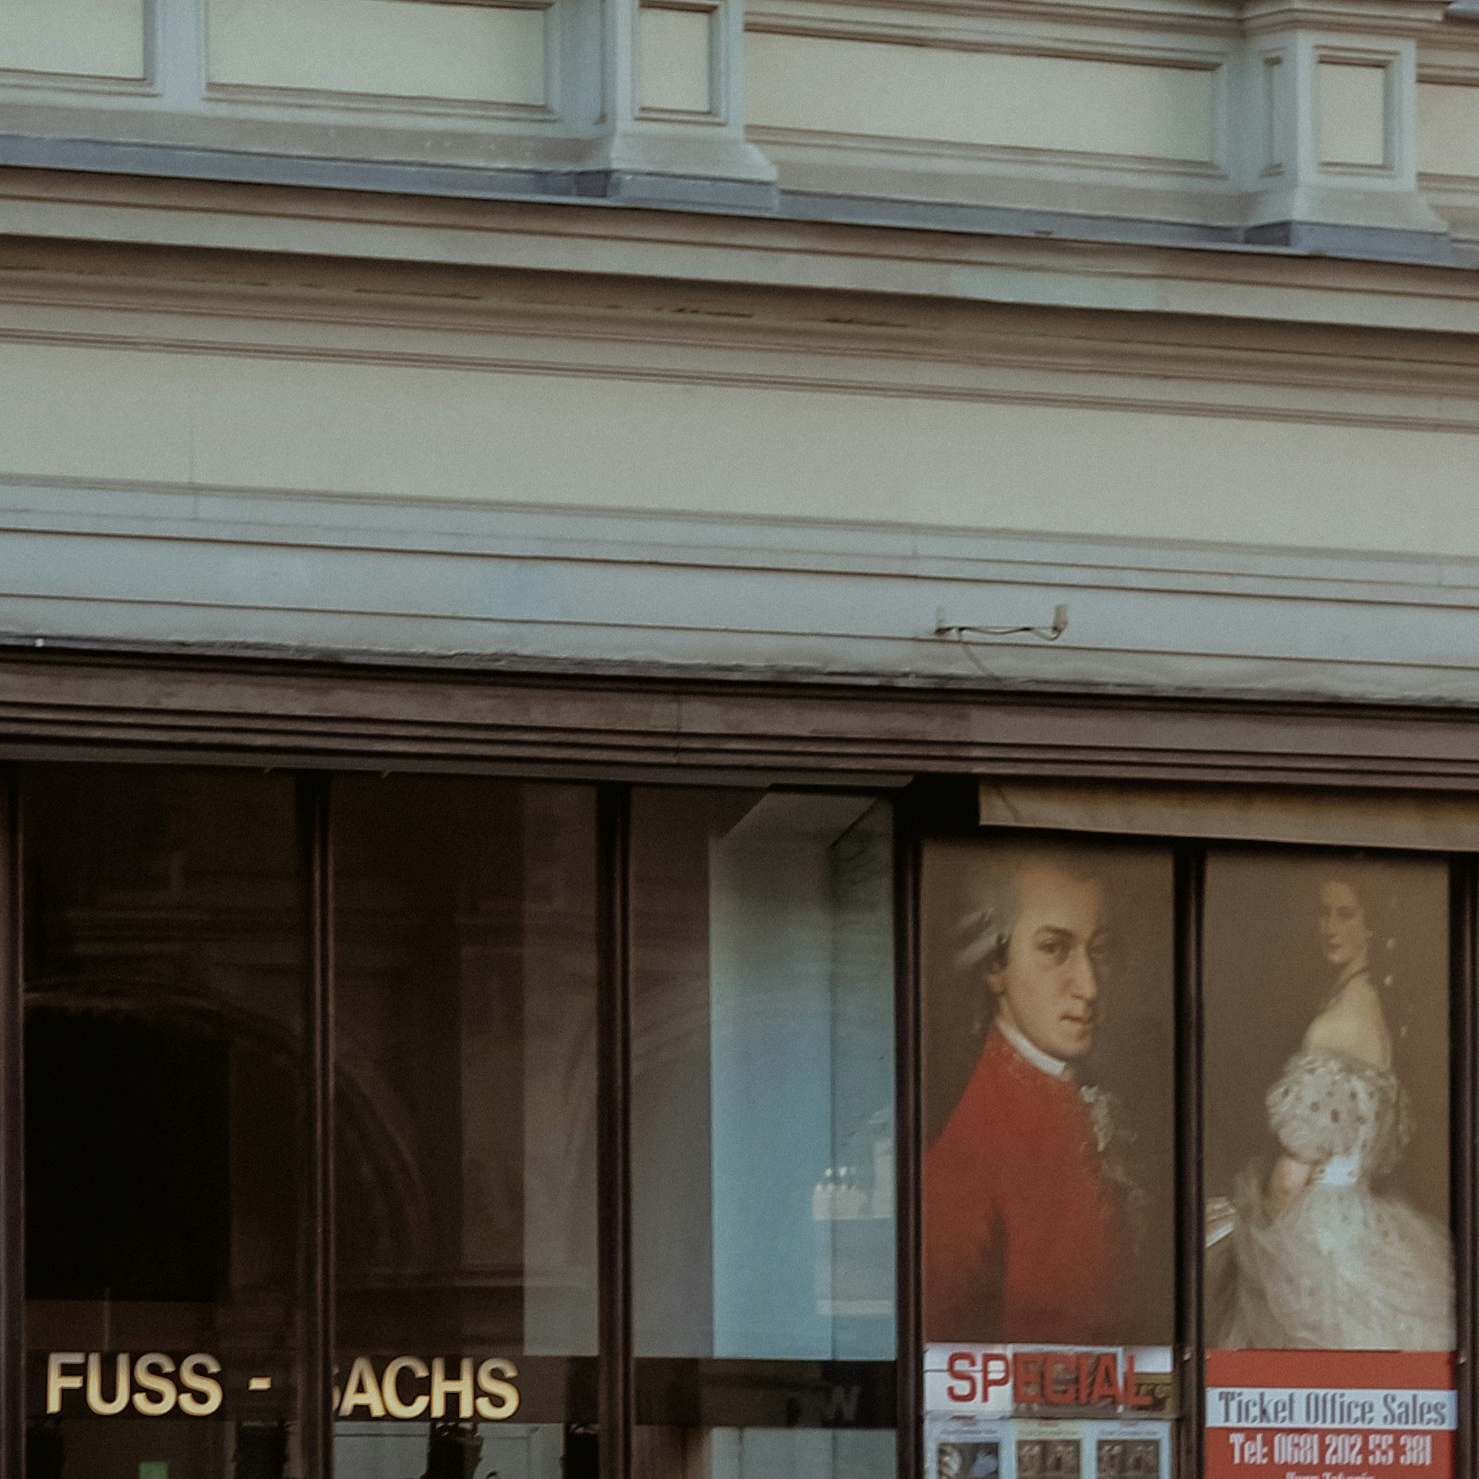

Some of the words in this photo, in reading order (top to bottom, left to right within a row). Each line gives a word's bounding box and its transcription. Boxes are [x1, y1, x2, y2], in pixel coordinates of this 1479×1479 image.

[46, 1352, 223, 1416] FUSS
[331, 1356, 520, 1420] ACHS
[947, 1352, 1152, 1406] SPECIAL
[1218, 1390, 1296, 1424] Ticket
[1305, 1390, 1375, 1425] Office
[1382, 1392, 1447, 1427] Sales
[1324, 1433, 1363, 1466] 202
[1368, 1433, 1394, 1466] 55
